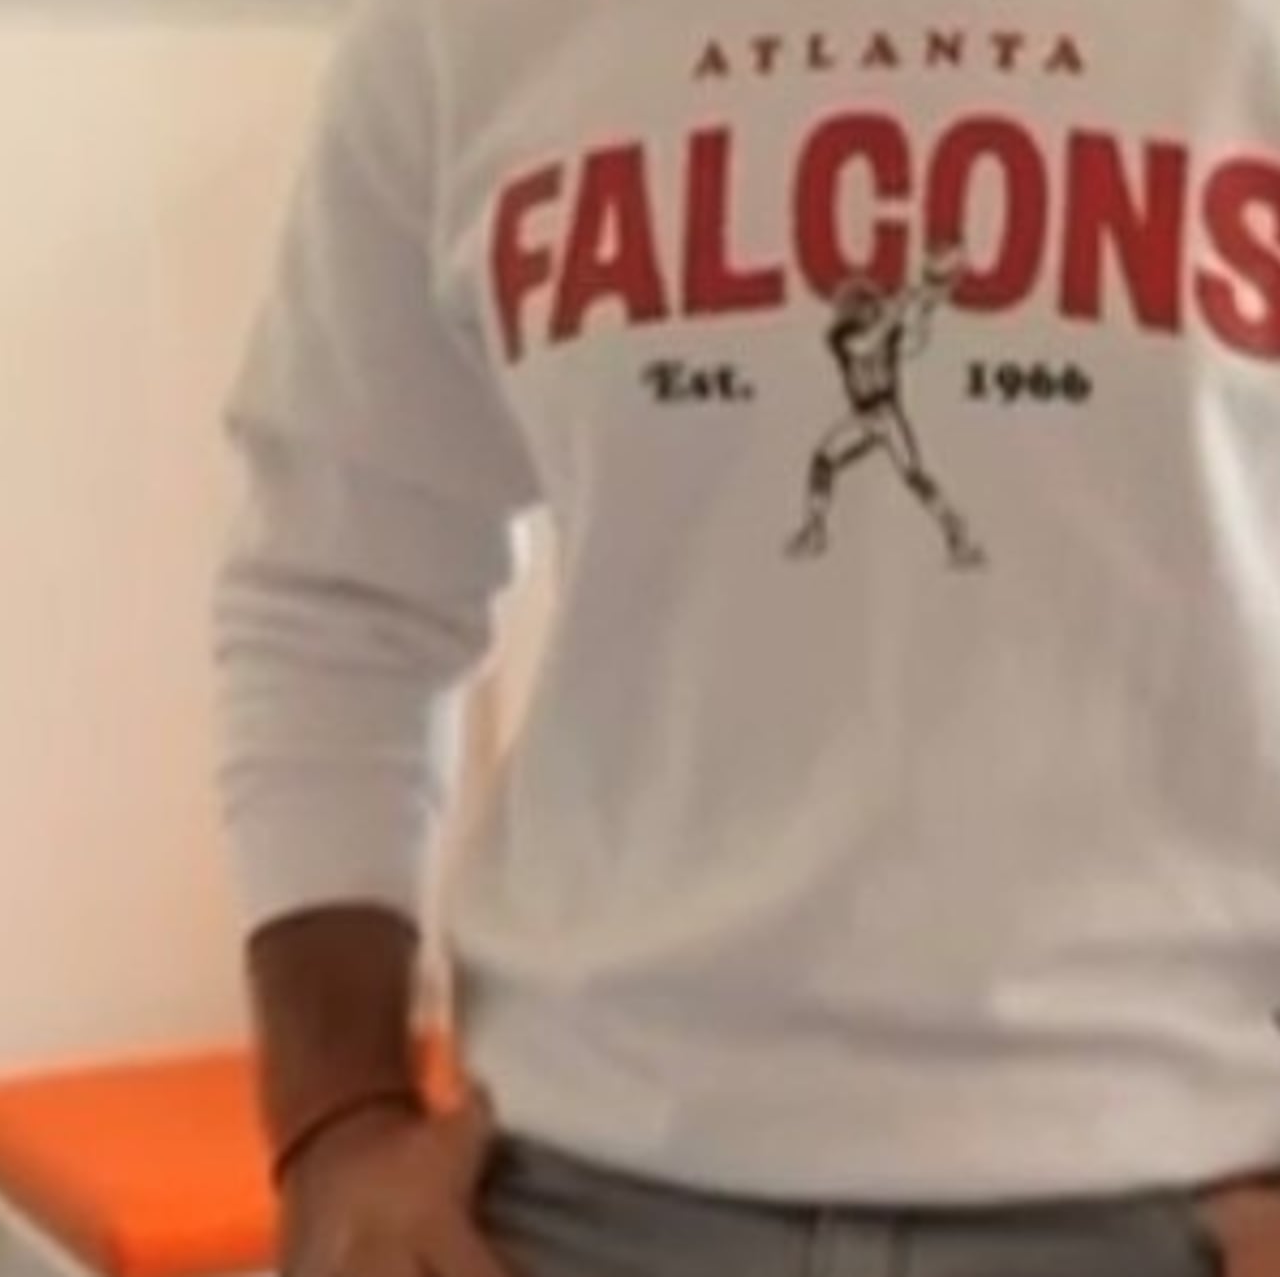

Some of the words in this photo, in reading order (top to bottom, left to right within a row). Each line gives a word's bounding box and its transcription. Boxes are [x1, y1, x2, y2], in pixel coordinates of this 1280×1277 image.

[692, 29, 1086, 80] ATLANTA
[642, 360, 756, 404] Est.
[962, 360, 1092, 404] 1966
